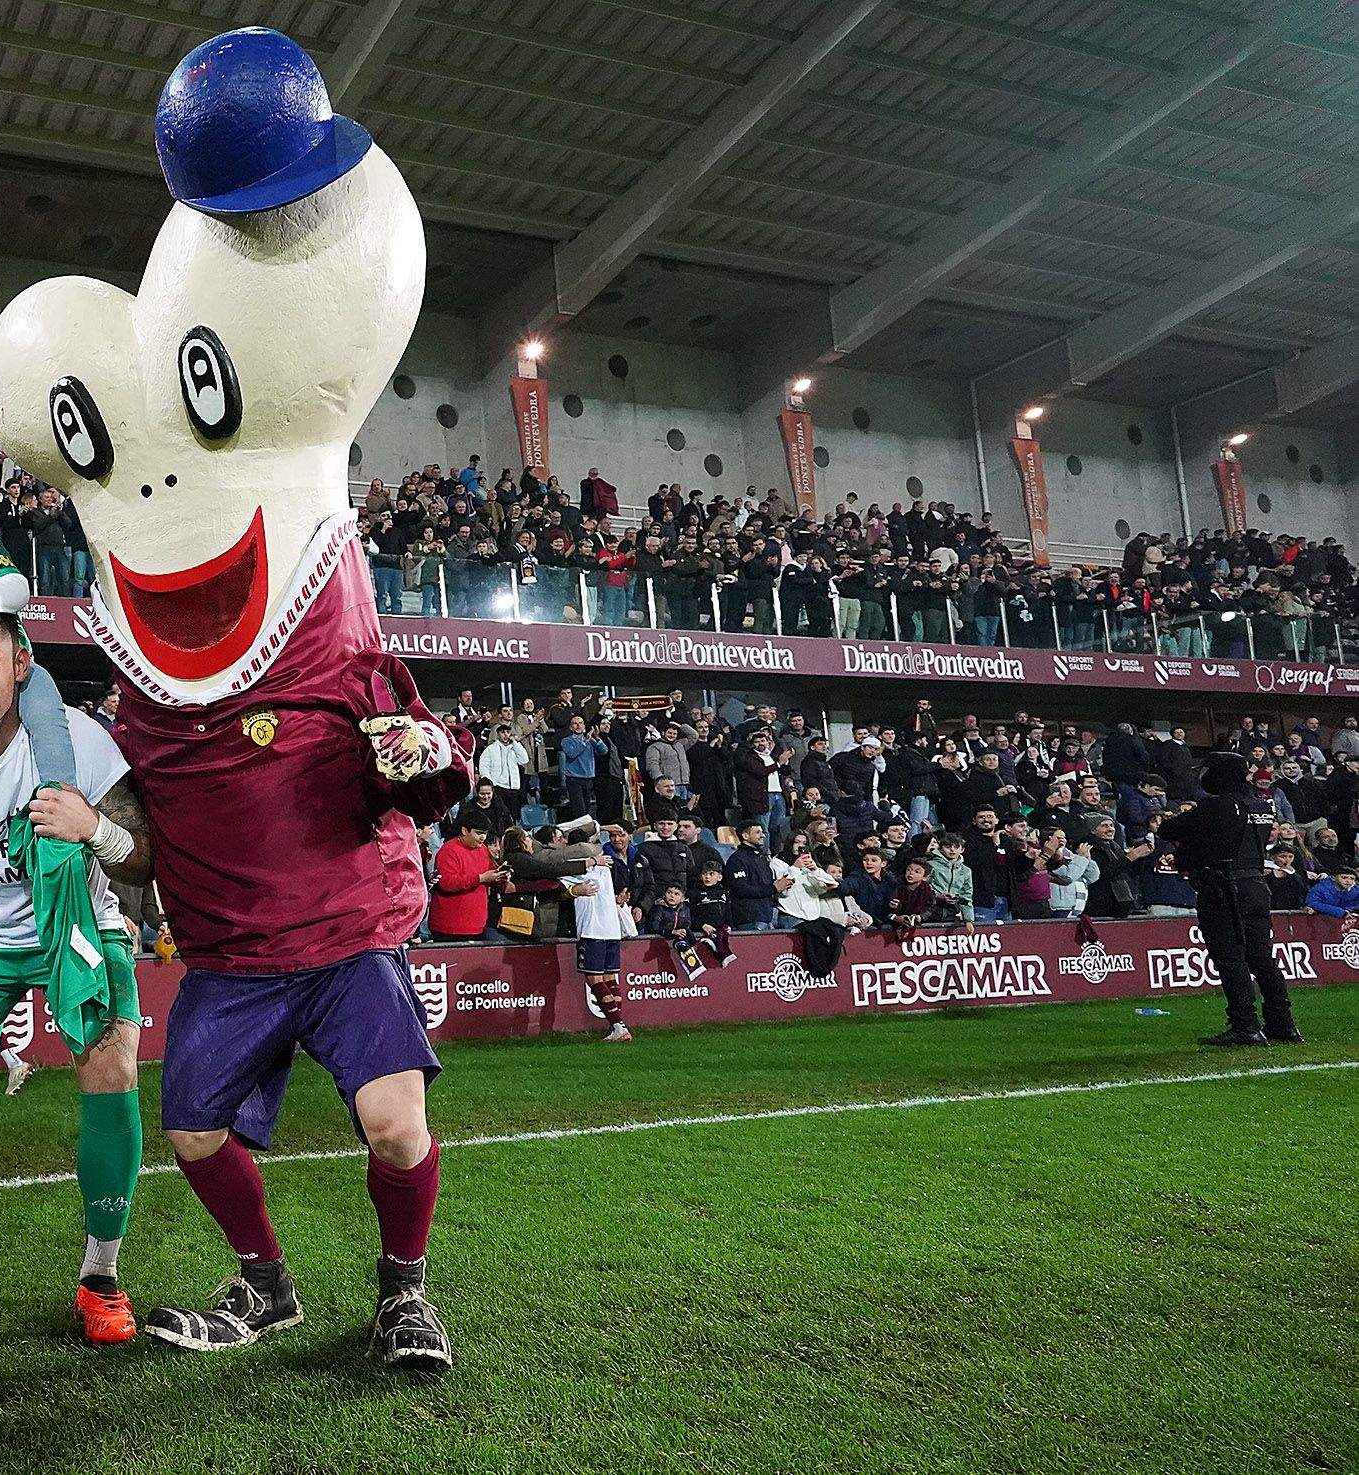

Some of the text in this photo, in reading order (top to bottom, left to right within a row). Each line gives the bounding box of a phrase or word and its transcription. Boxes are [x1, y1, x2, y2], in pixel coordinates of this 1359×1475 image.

[19, 612, 56, 621] AUDABLE
[457, 636, 530, 659] PALACE
[1067, 655, 1094, 664] DEPORTE
[901, 932, 1002, 957] CONSERVAS
[1058, 954, 1136, 975] PESCAMAR
[626, 971, 676, 986] Concello
[850, 954, 1053, 1007] PESCAMAR
[455, 980, 510, 995] Concello
[627, 984, 709, 1001] de Pontevedra
[456, 994, 546, 1011] de Pontevedra
